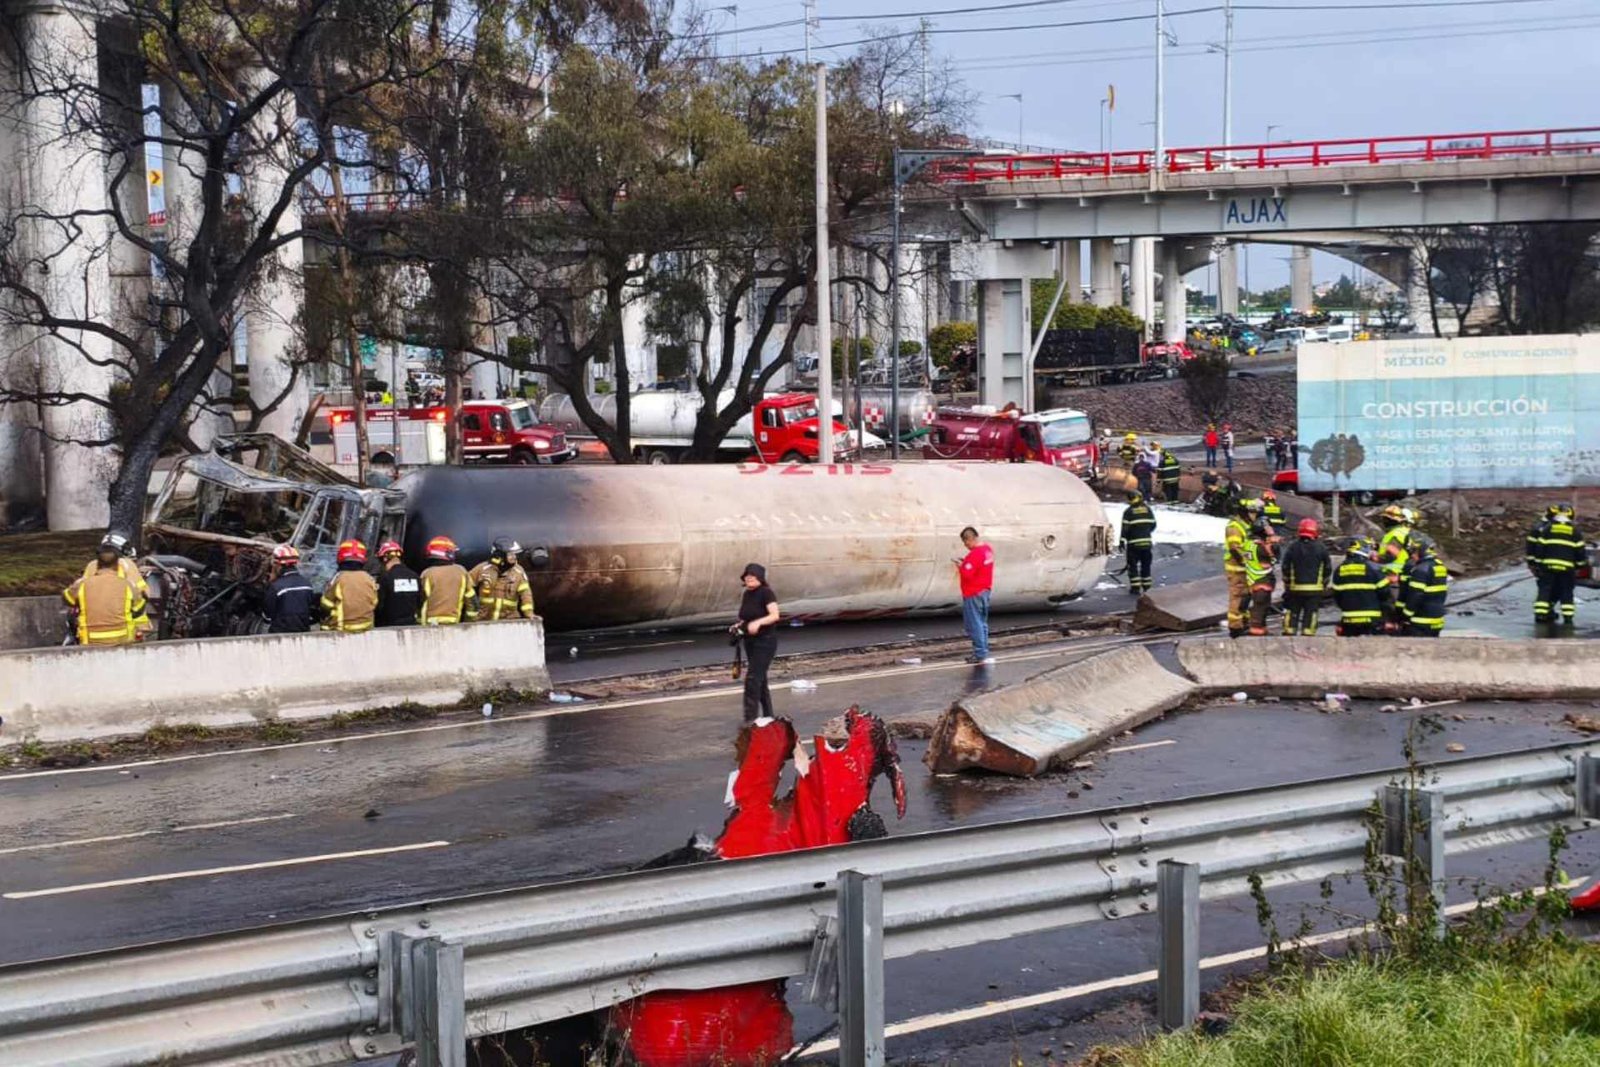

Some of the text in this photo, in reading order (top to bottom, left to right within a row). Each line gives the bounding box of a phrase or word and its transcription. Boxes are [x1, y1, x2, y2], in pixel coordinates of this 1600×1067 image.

[1227, 198, 1286, 224] AJAX
[1384, 354, 1446, 367] MÉXICO
[1362, 395, 1548, 418] CONSTRUCCIÓN
